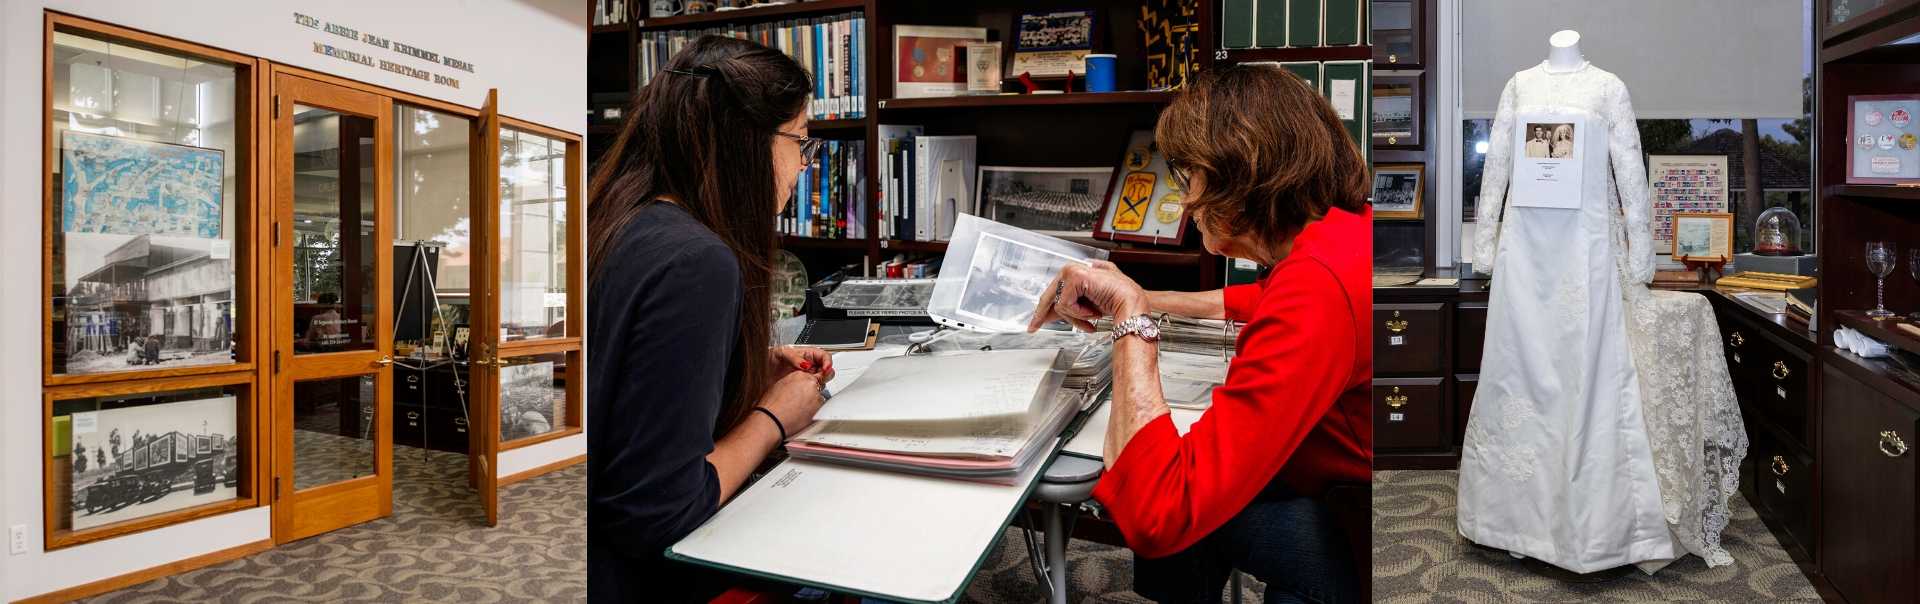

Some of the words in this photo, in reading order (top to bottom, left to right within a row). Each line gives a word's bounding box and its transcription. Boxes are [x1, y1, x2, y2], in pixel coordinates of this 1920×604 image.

[294, 12, 319, 29] THE
[324, 22, 359, 40] ABBIE
[362, 33, 390, 49] JEAN
[393, 41, 440, 64] KRIMMEL
[443, 56, 475, 73] MESAK
[313, 41, 375, 67] MEMORIAL
[379, 59, 430, 81] HERITAGE
[433, 73, 460, 89] ROOM
[1215, 50, 1228, 60] 23
